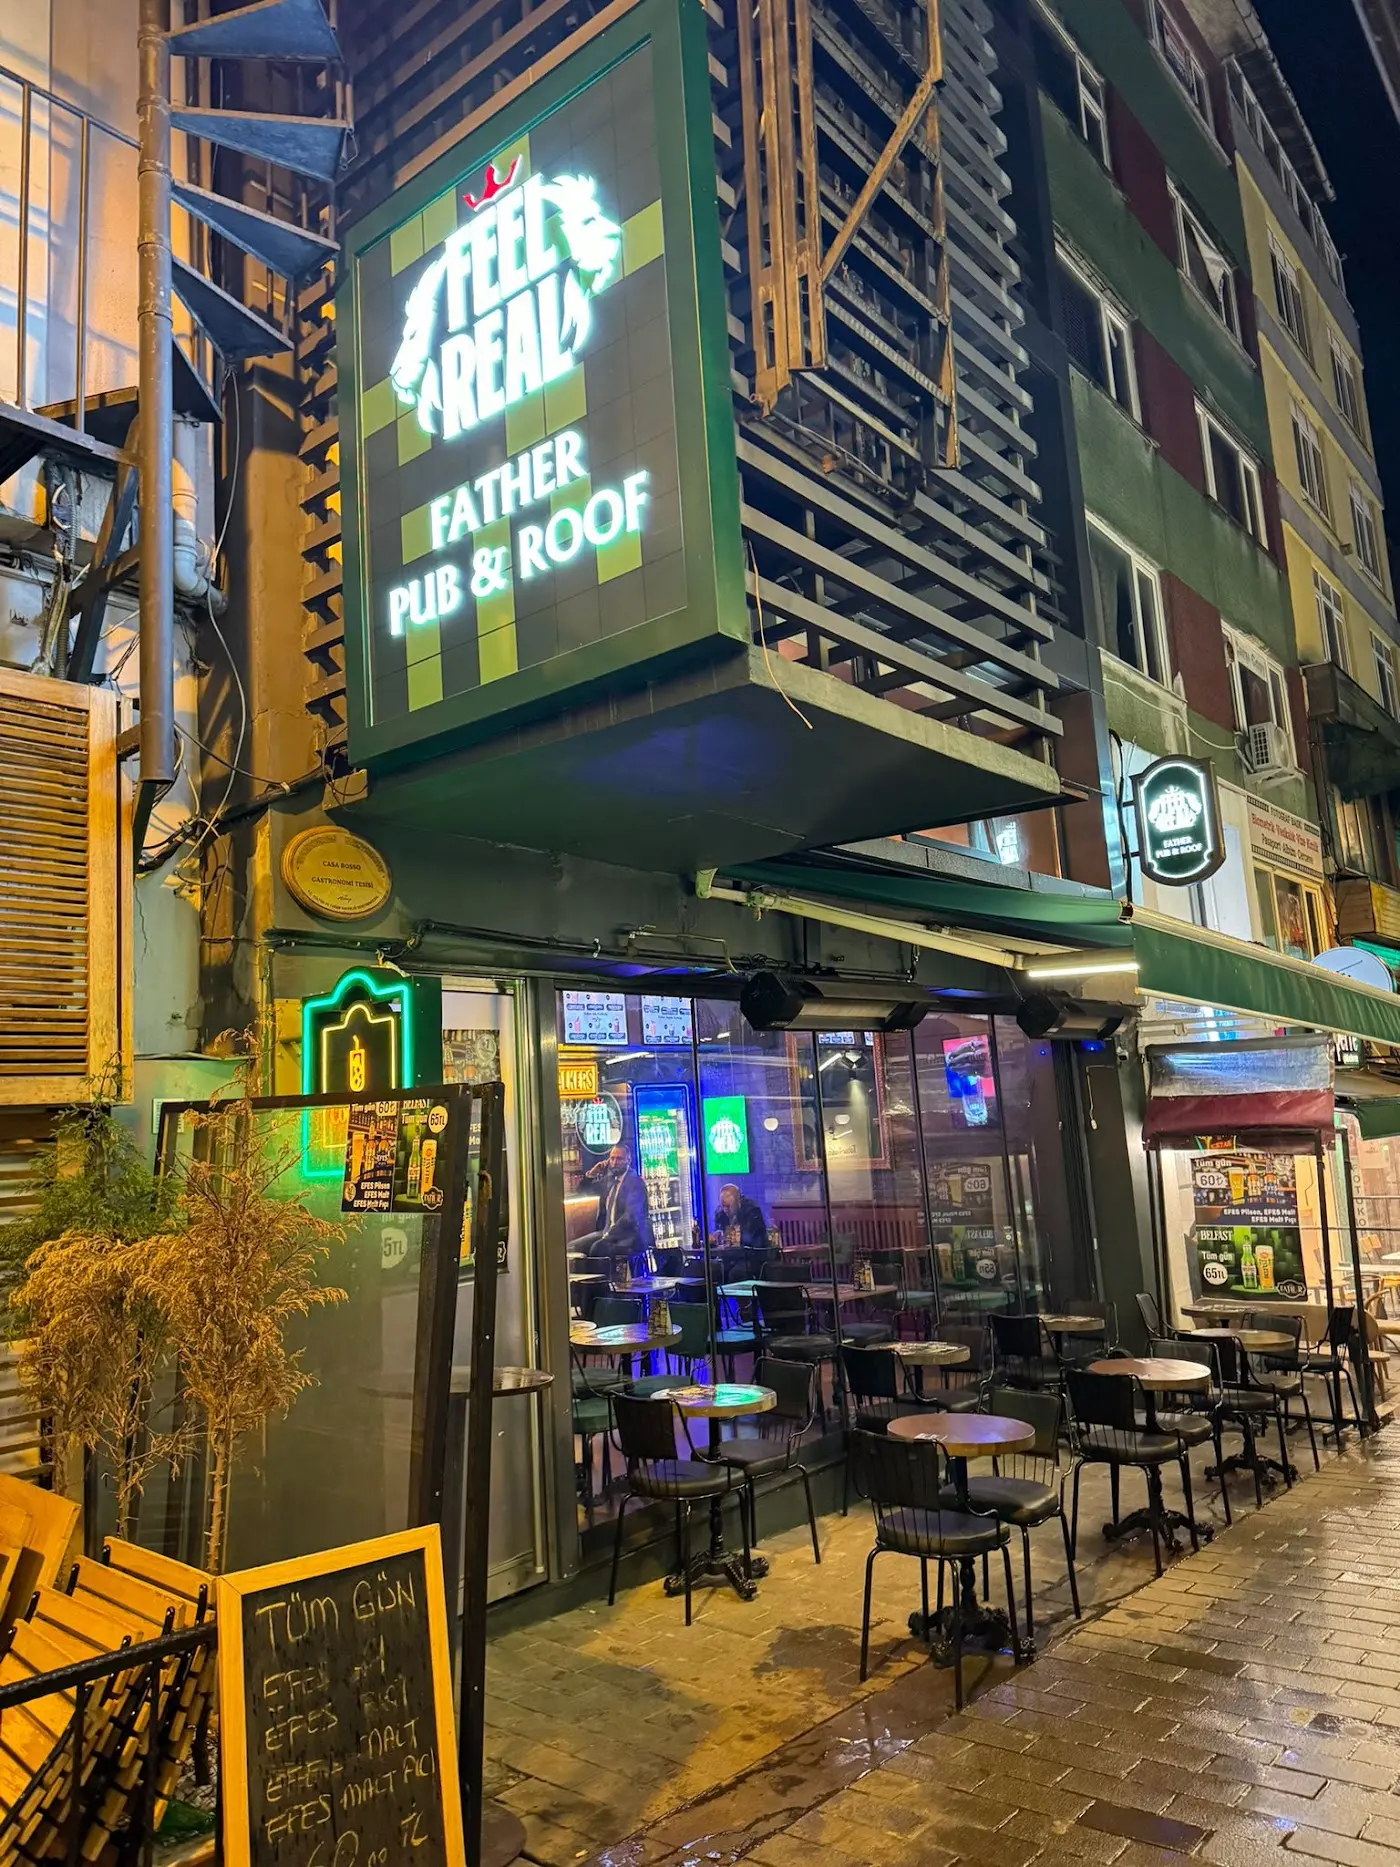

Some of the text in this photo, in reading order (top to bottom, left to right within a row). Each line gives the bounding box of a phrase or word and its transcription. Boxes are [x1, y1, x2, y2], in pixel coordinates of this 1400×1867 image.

[446, 174, 560, 332] FEEL
[441, 273, 574, 440] REAL
[430, 430, 588, 551] FATHER
[389, 471, 652, 637] PUB & ROOF
[1163, 836, 1192, 848] FATHER
[1155, 842, 1202, 858] PUB & ROOF
[322, 860, 340, 869] CASA
[311, 876, 354, 887] GASTRONOMİ
[559, 1070, 594, 1090] ALKERS
[470, 1123, 482, 1133] FES
[1195, 1158, 1232, 1168] Tüm gün
[361, 1181, 390, 1190] EFES Pilsen
[364, 1191, 377, 1199] EFES
[378, 1191, 389, 1199] Malt
[1223, 1208, 1240, 1216] EFES
[1200, 1230, 1233, 1241] BELFAST
[383, 1237, 404, 1257] 5TL
[1201, 1251, 1233, 1262] Tüm gün
[1205, 1268, 1226, 1279] 65TL
[255, 1571, 416, 1656] TÜM GÜN
[265, 1702, 338, 1751] EFES
[340, 1770, 398, 1810] MALT
